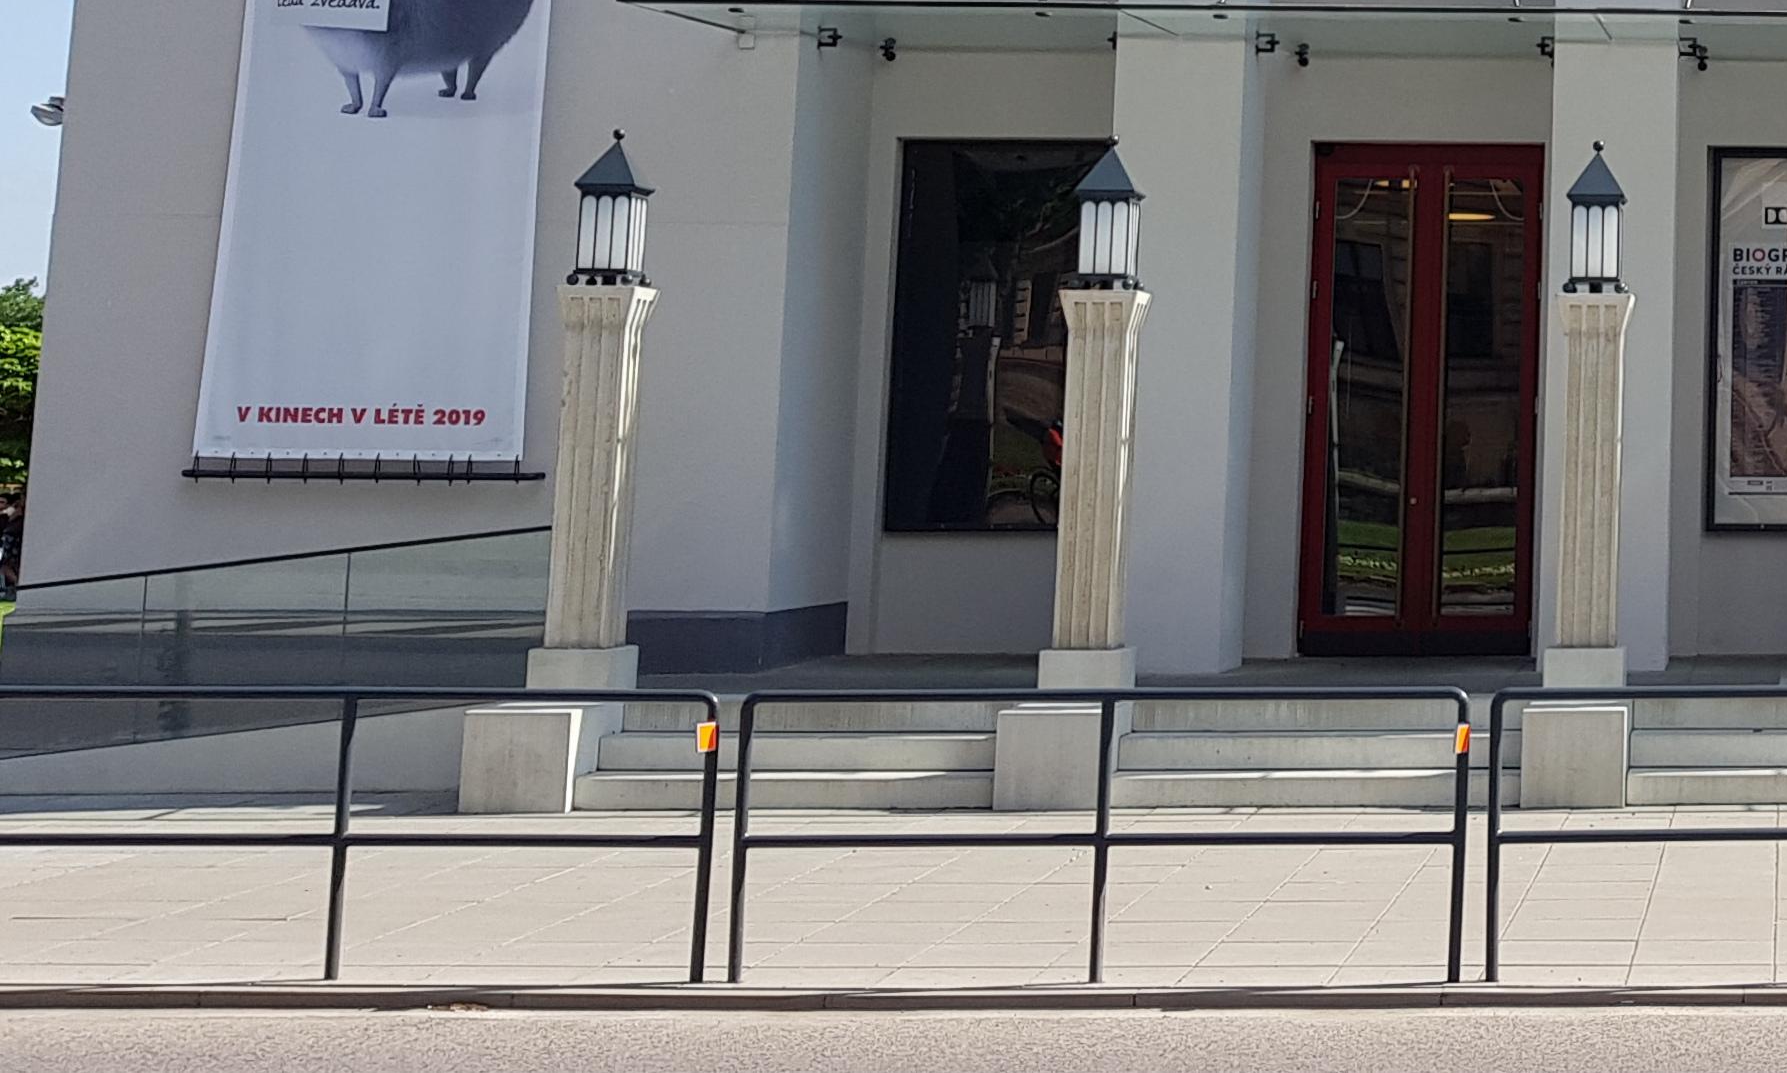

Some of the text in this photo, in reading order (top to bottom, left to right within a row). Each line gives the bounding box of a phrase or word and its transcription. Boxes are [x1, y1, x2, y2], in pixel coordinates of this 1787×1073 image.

[1733, 264, 1773, 276] ČESKÝ
[236, 403, 486, 426] V KINECH V LÉTĚ 2019
